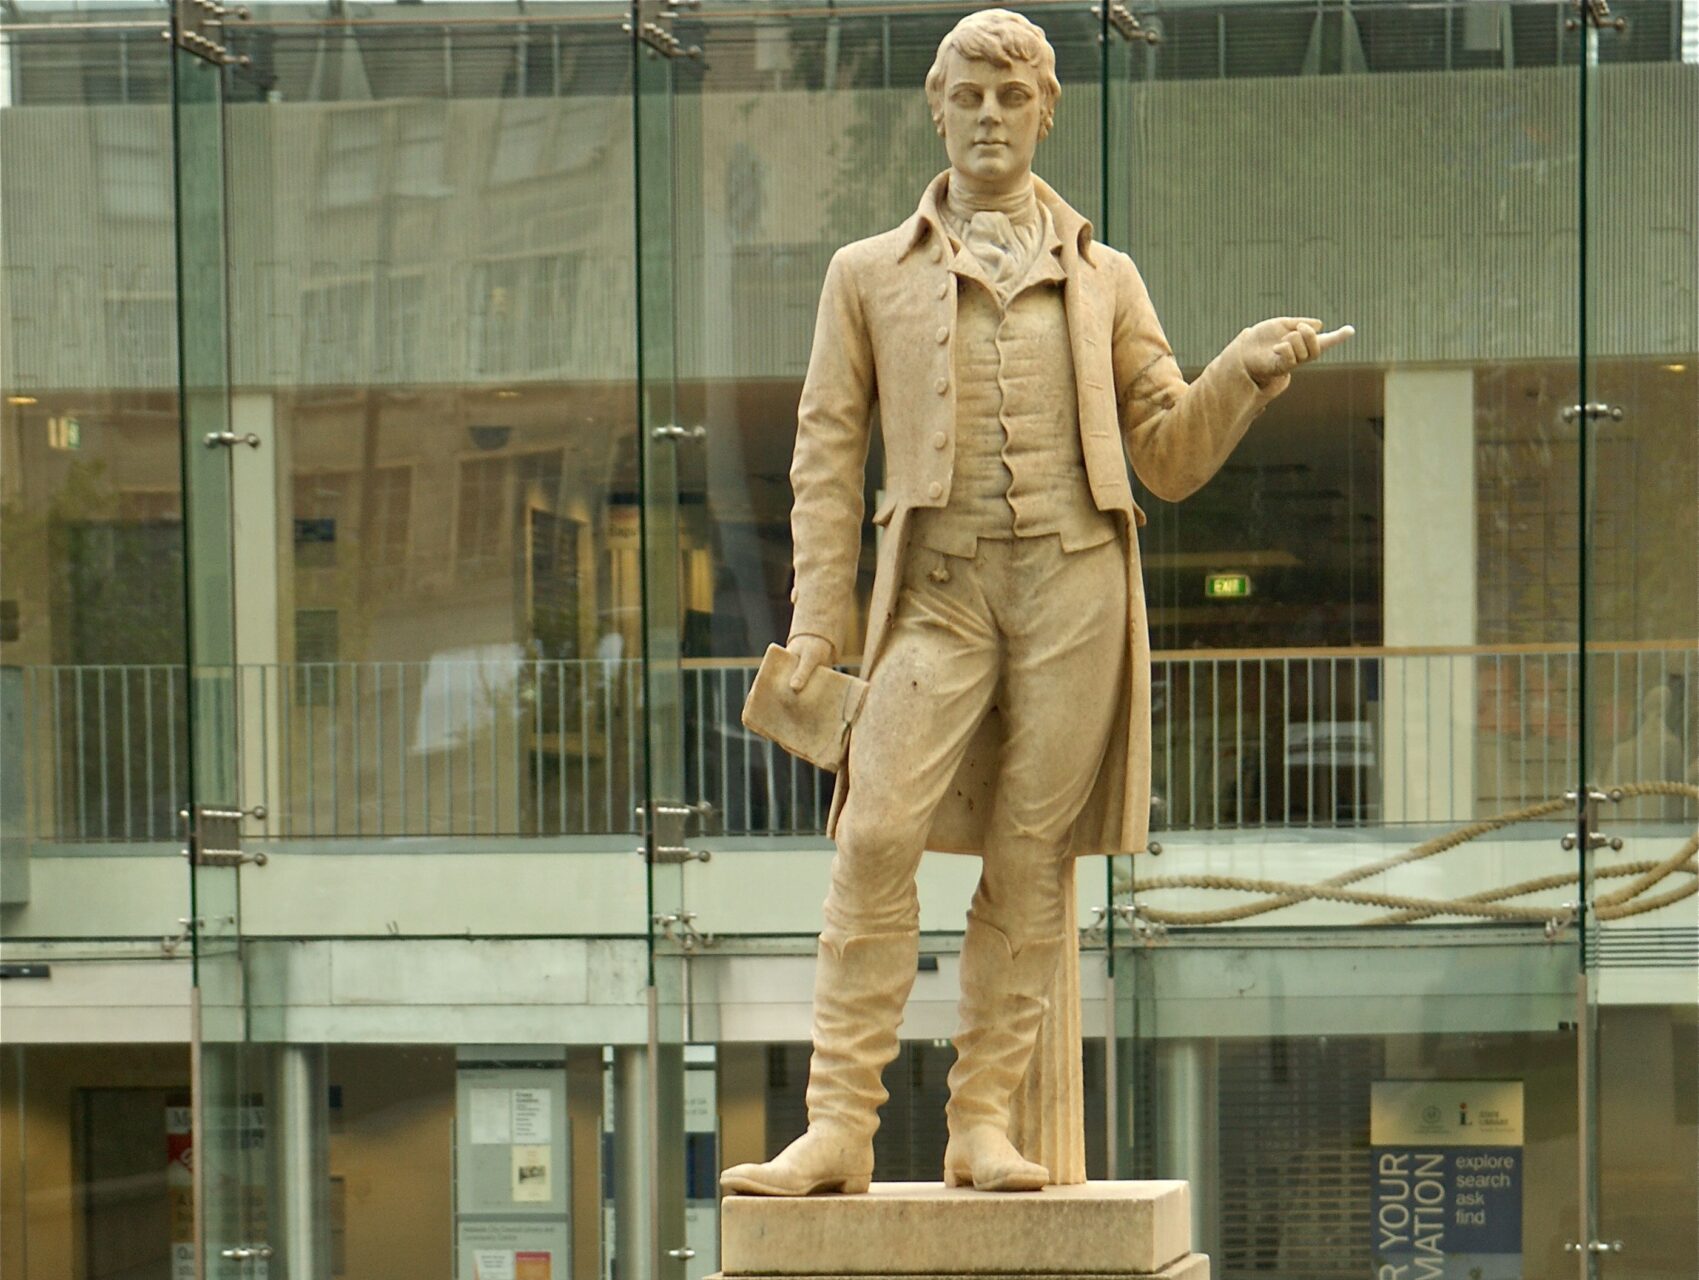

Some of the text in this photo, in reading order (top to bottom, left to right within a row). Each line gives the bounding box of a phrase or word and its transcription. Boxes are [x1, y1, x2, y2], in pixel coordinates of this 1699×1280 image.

[1455, 1154, 1514, 1170] explore
[1455, 1173, 1511, 1188] search
[1379, 1153, 1409, 1250] YOUR
[1455, 1191, 1485, 1206] ask
[1455, 1209, 1486, 1225] find
